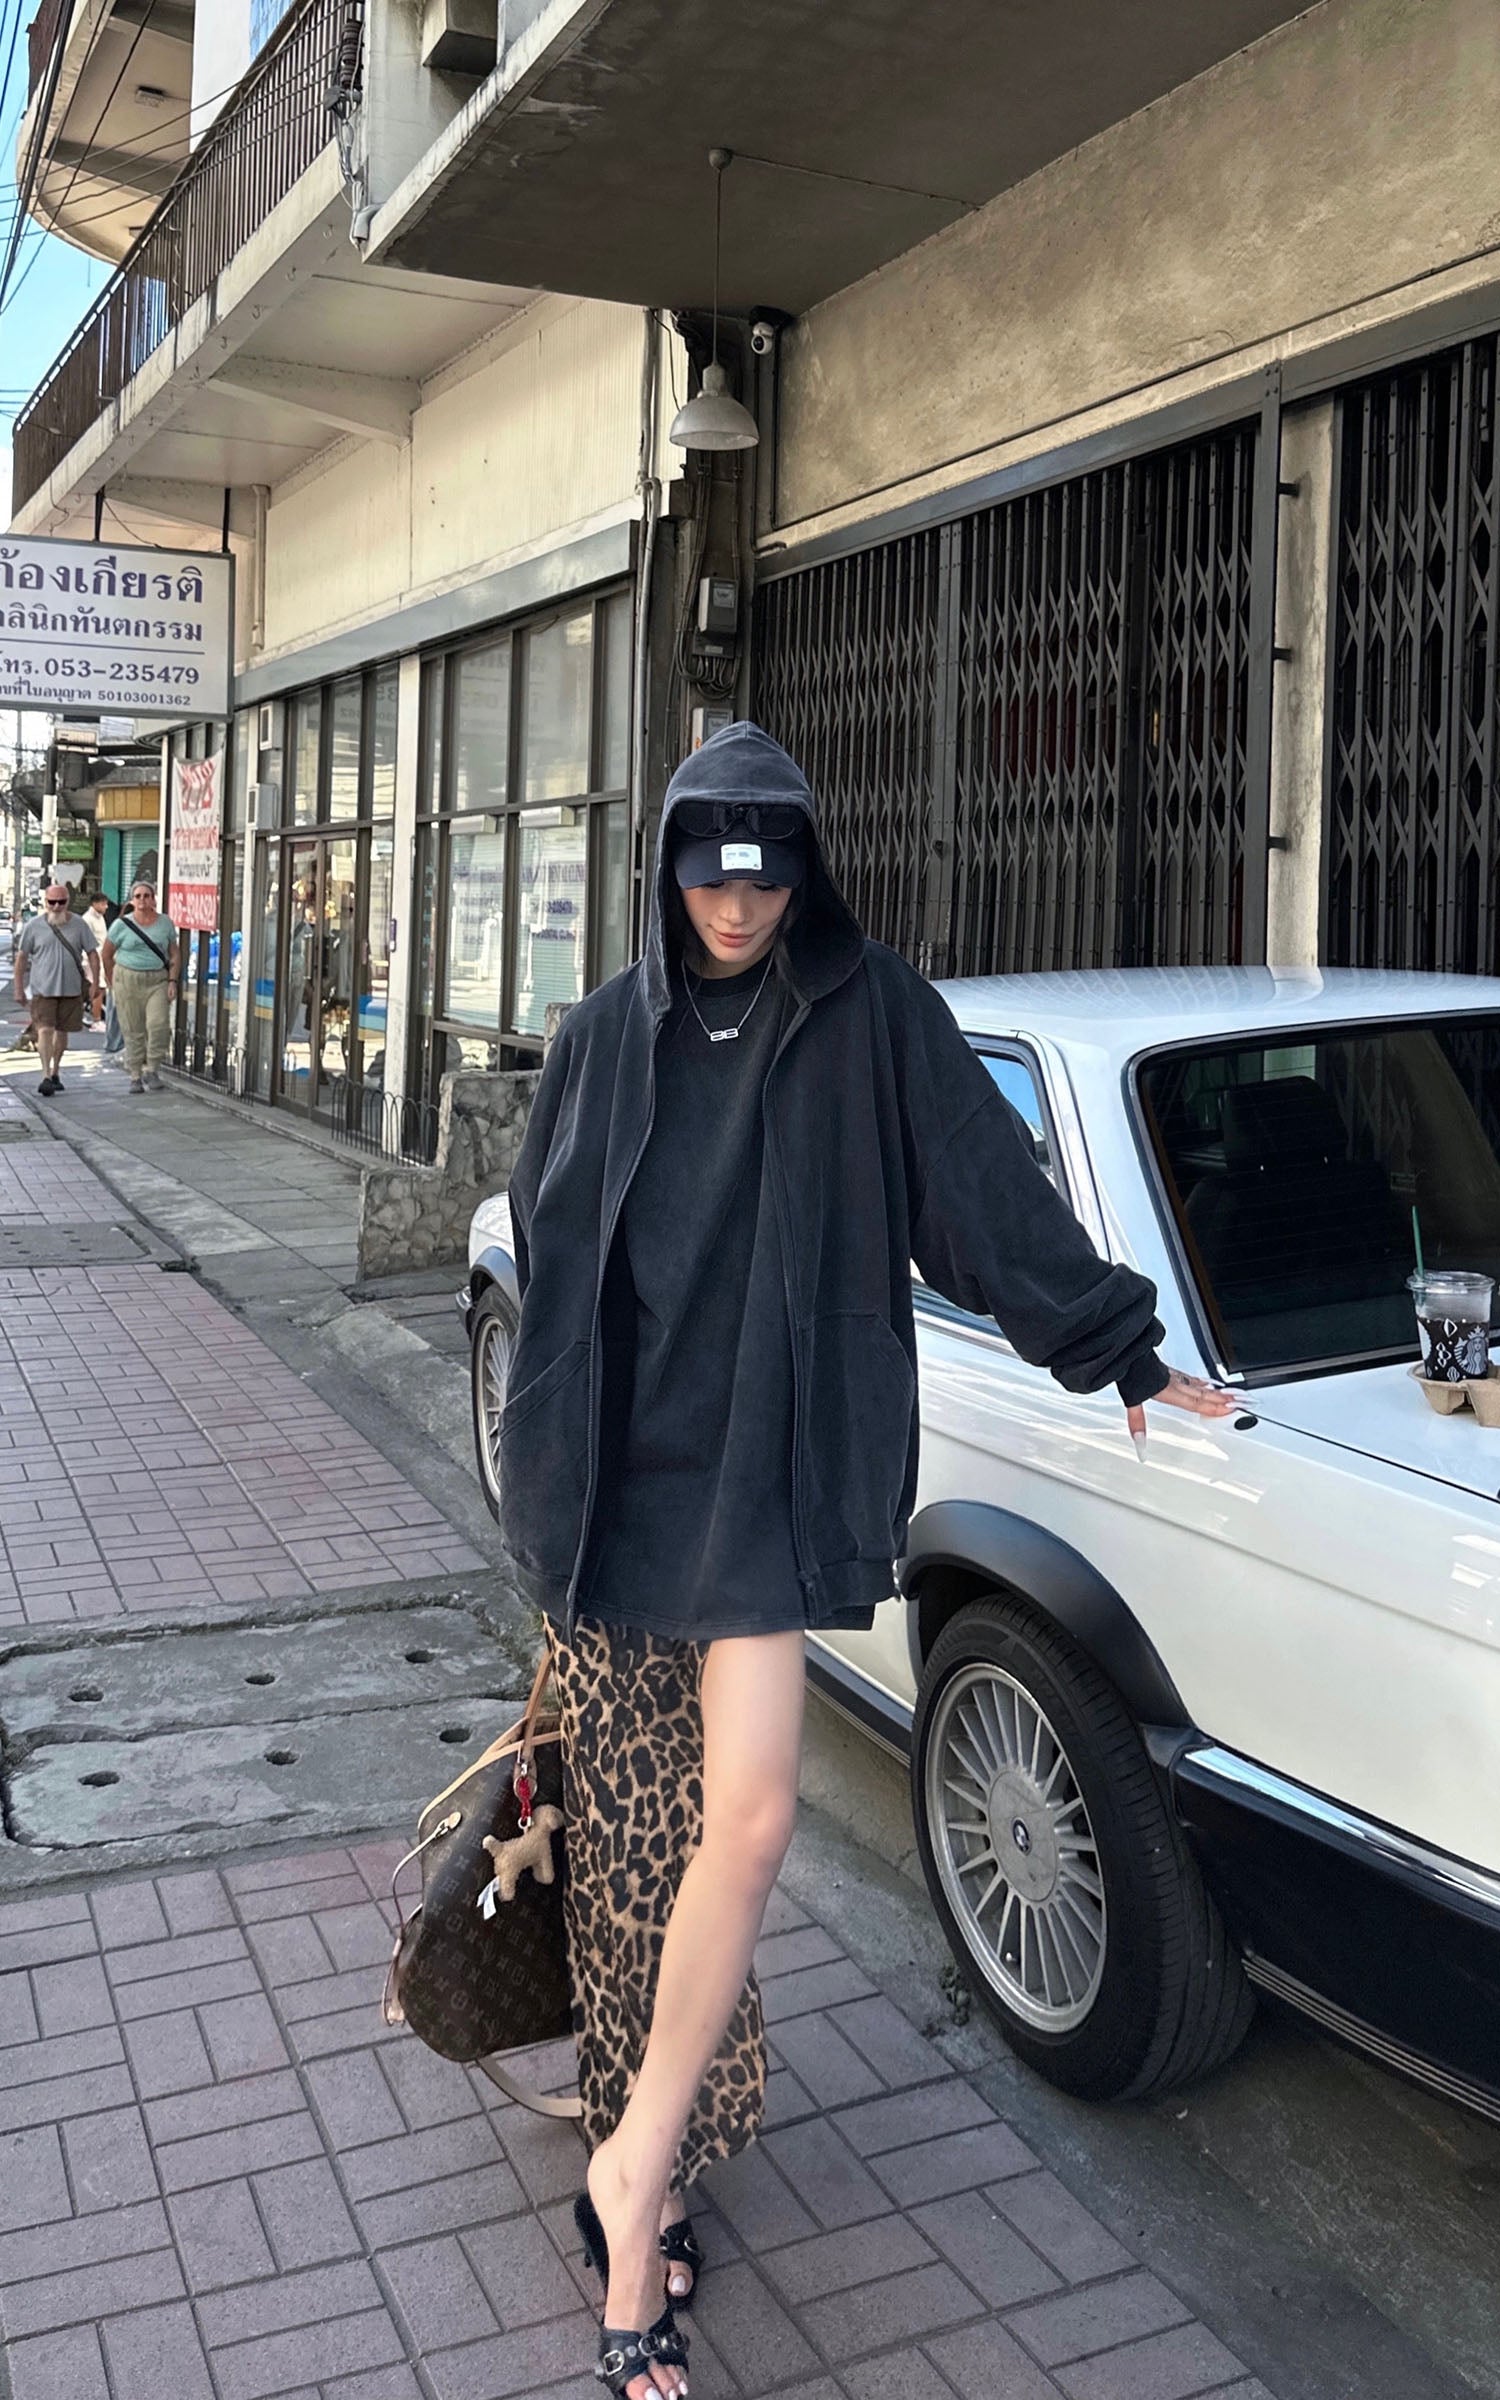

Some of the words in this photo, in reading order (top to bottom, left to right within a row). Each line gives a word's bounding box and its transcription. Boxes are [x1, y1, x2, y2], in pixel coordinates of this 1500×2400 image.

[0, 602, 202, 641] ลินิกทันตกรรม
[45, 658, 200, 684] 053-235479
[0, 676, 91, 703] ขที่ใบอนุญาต
[98, 690, 191, 706] 50103001362
